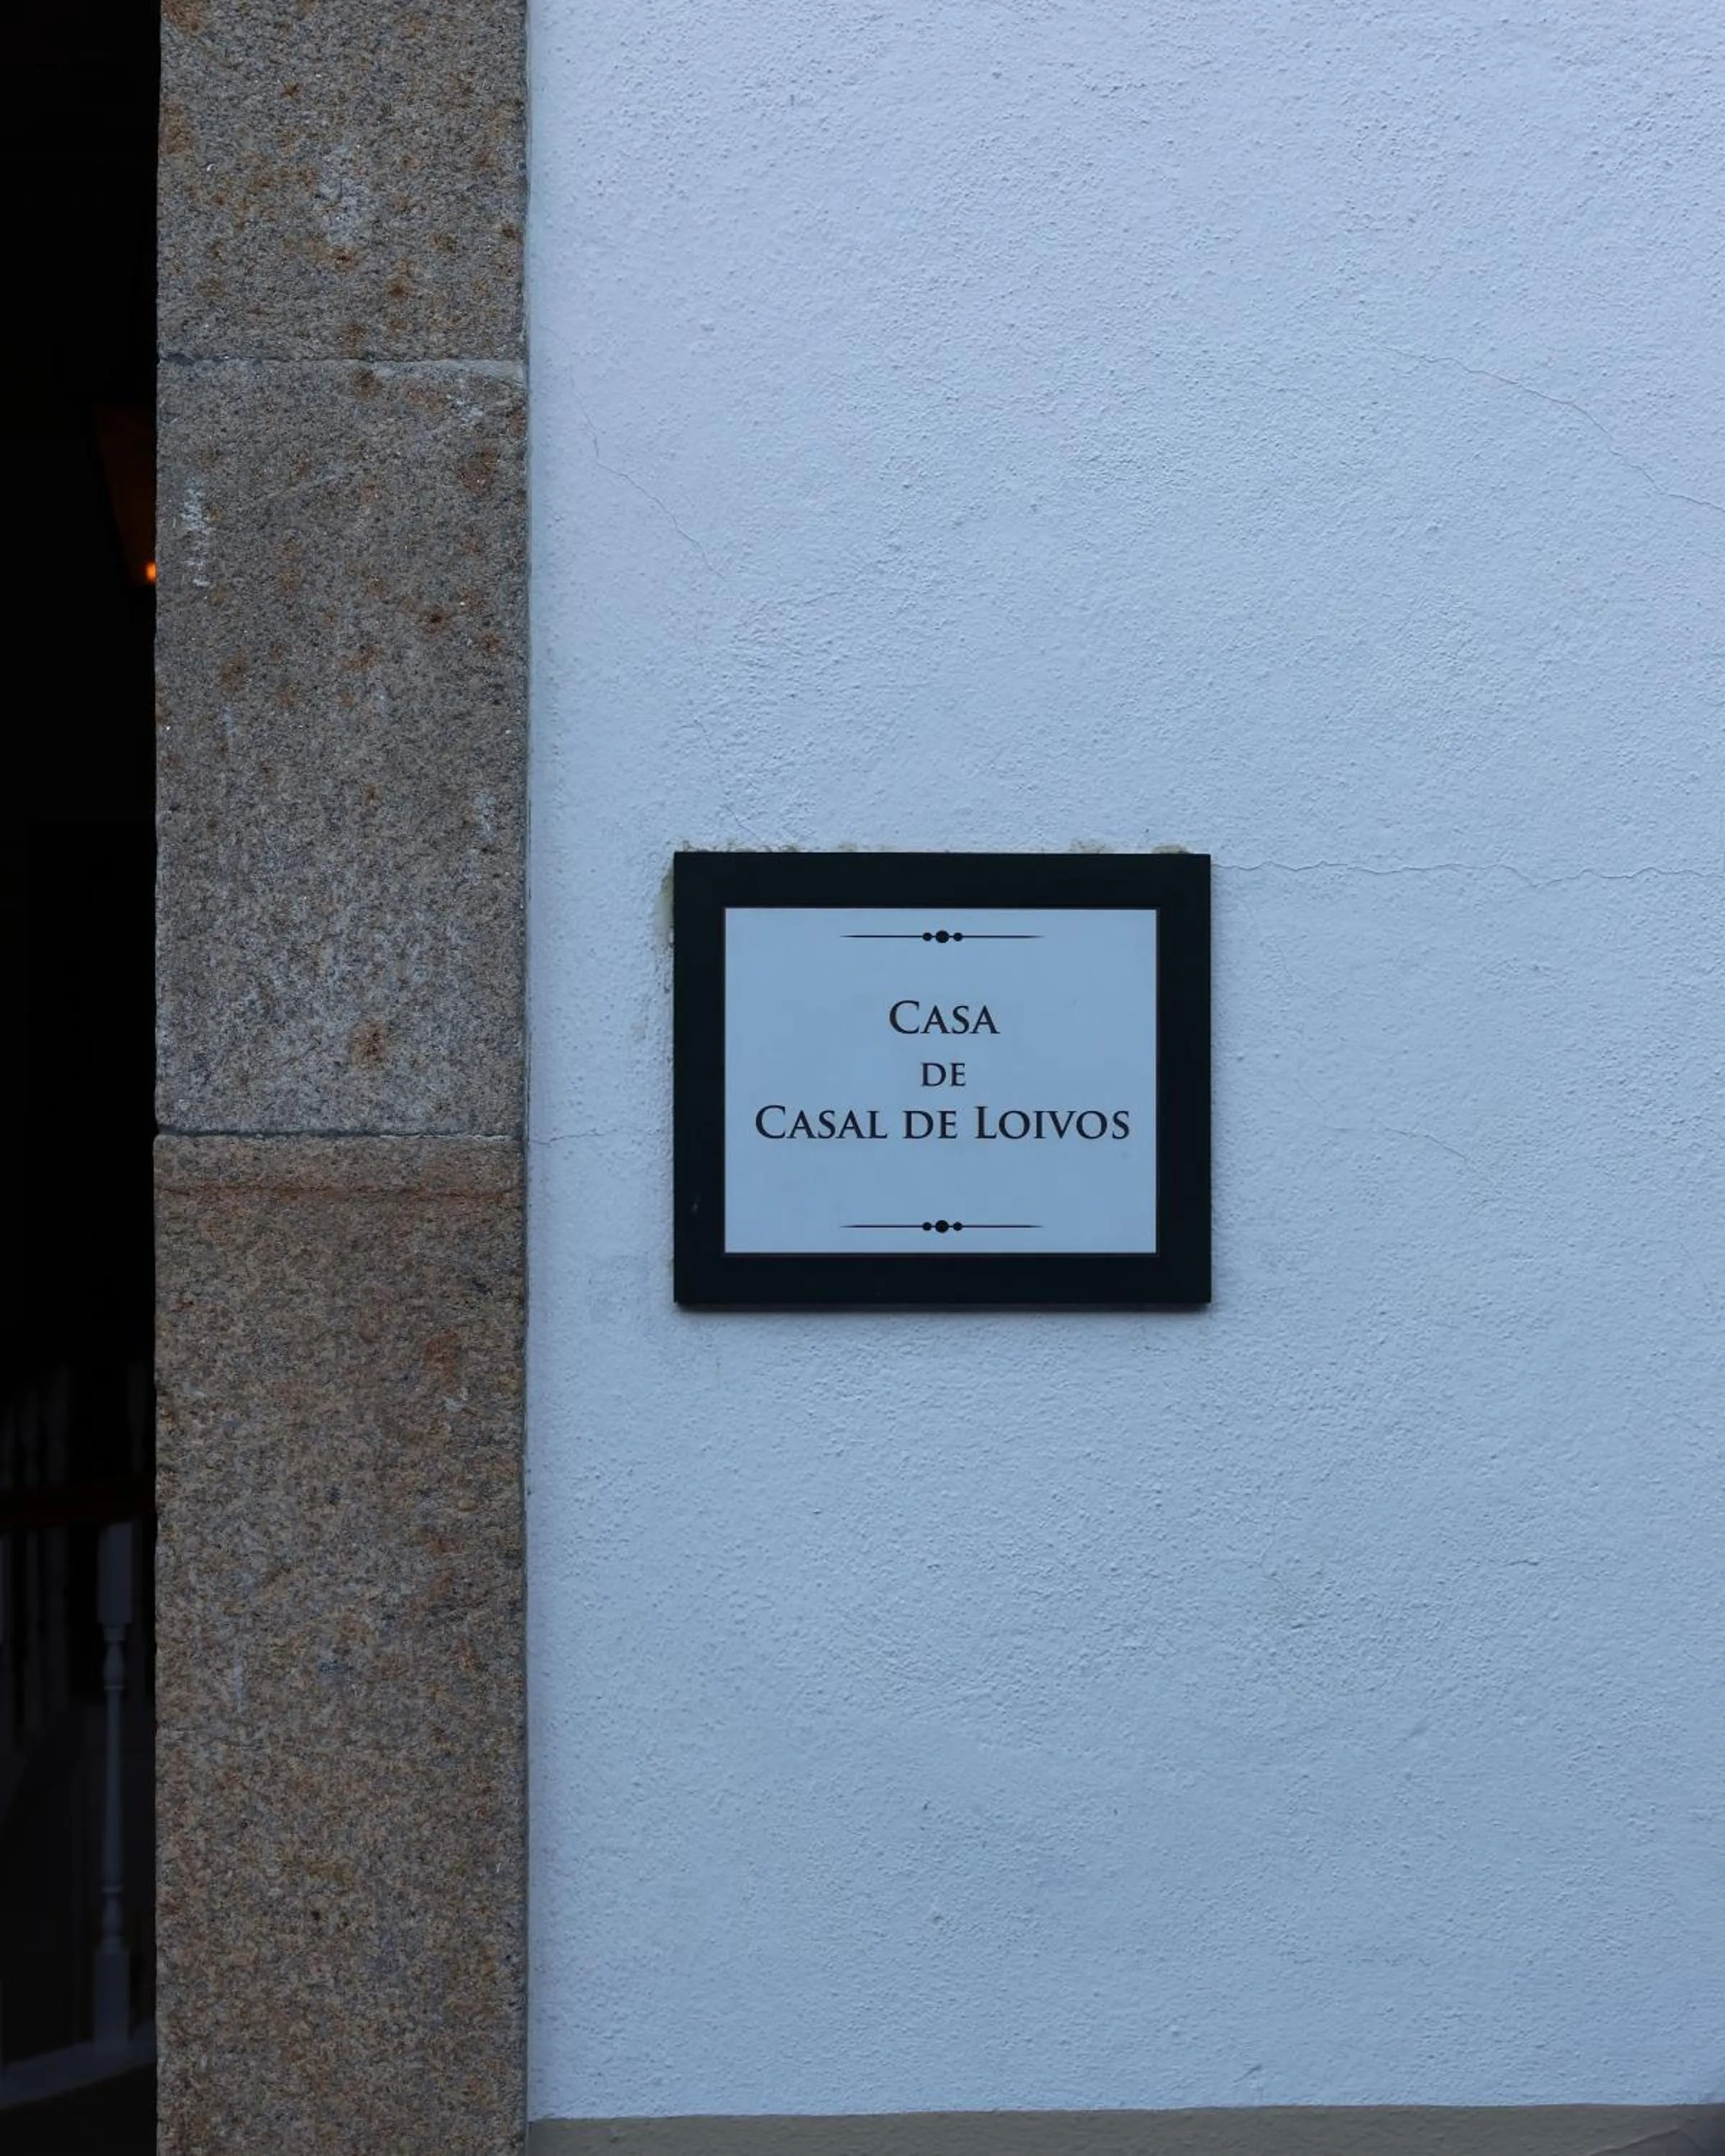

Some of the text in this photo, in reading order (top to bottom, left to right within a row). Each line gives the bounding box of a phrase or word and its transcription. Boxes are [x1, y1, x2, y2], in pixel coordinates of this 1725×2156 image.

[889, 1000, 1001, 1035] CASA
[920, 1061, 967, 1087] DE
[755, 1105, 1131, 1141] CASAL DE LOIVOS
